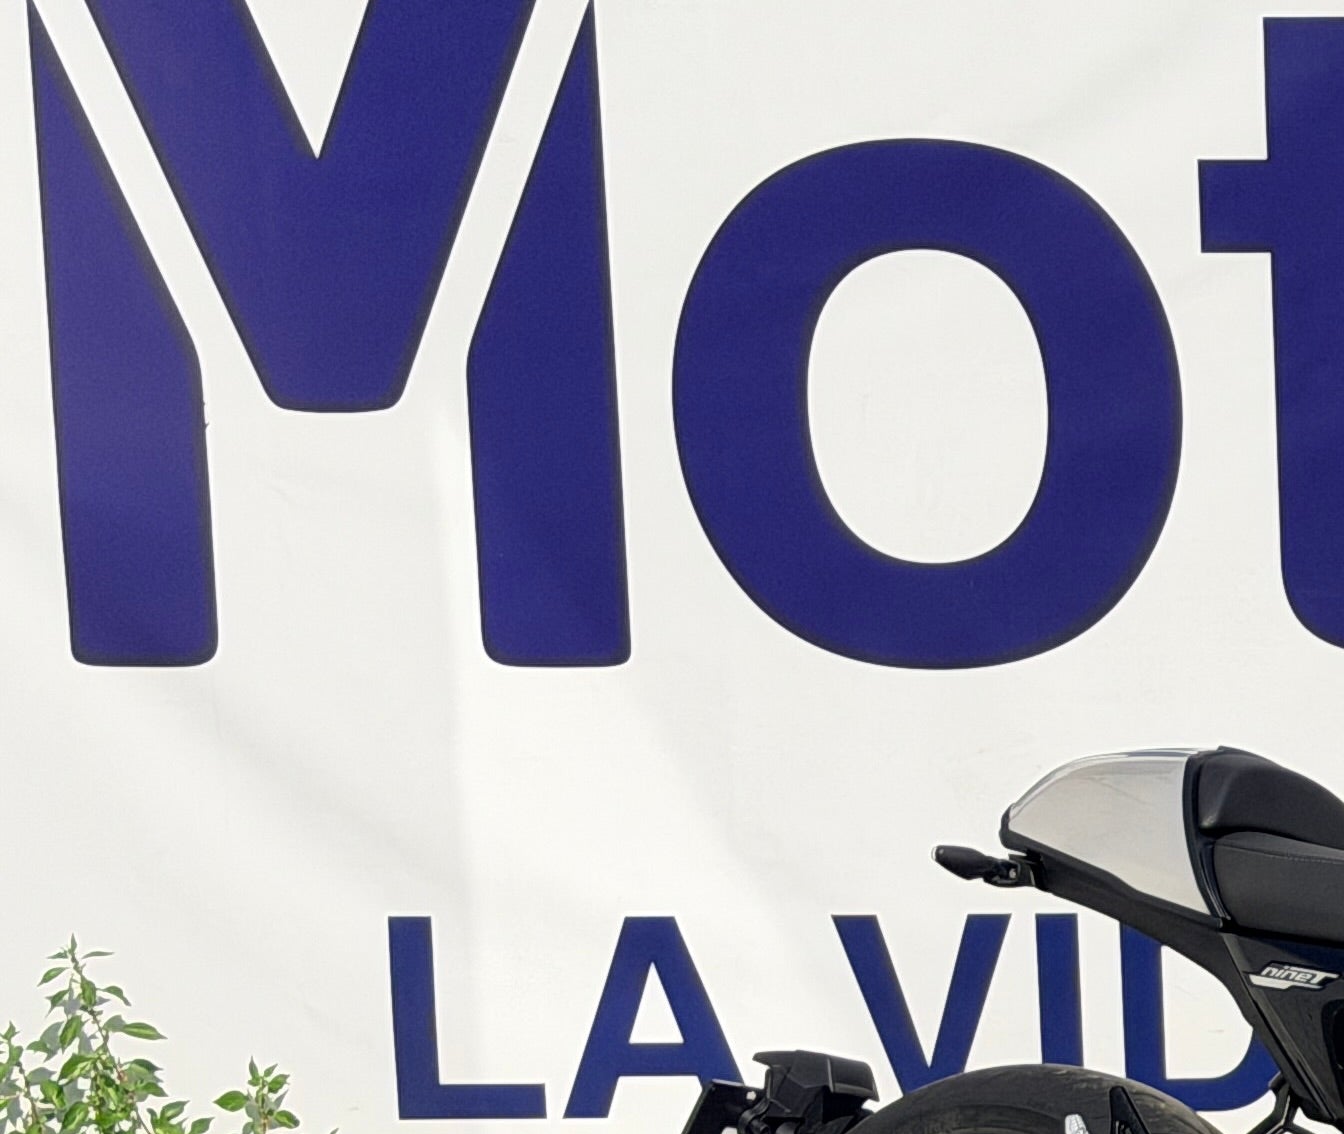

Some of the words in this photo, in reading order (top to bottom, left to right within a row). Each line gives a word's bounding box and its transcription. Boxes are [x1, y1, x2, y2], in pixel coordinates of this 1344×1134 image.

[388, 915, 745, 1120] LA
[832, 912, 1281, 1112] VID
[1258, 964, 1340, 987] nineT
